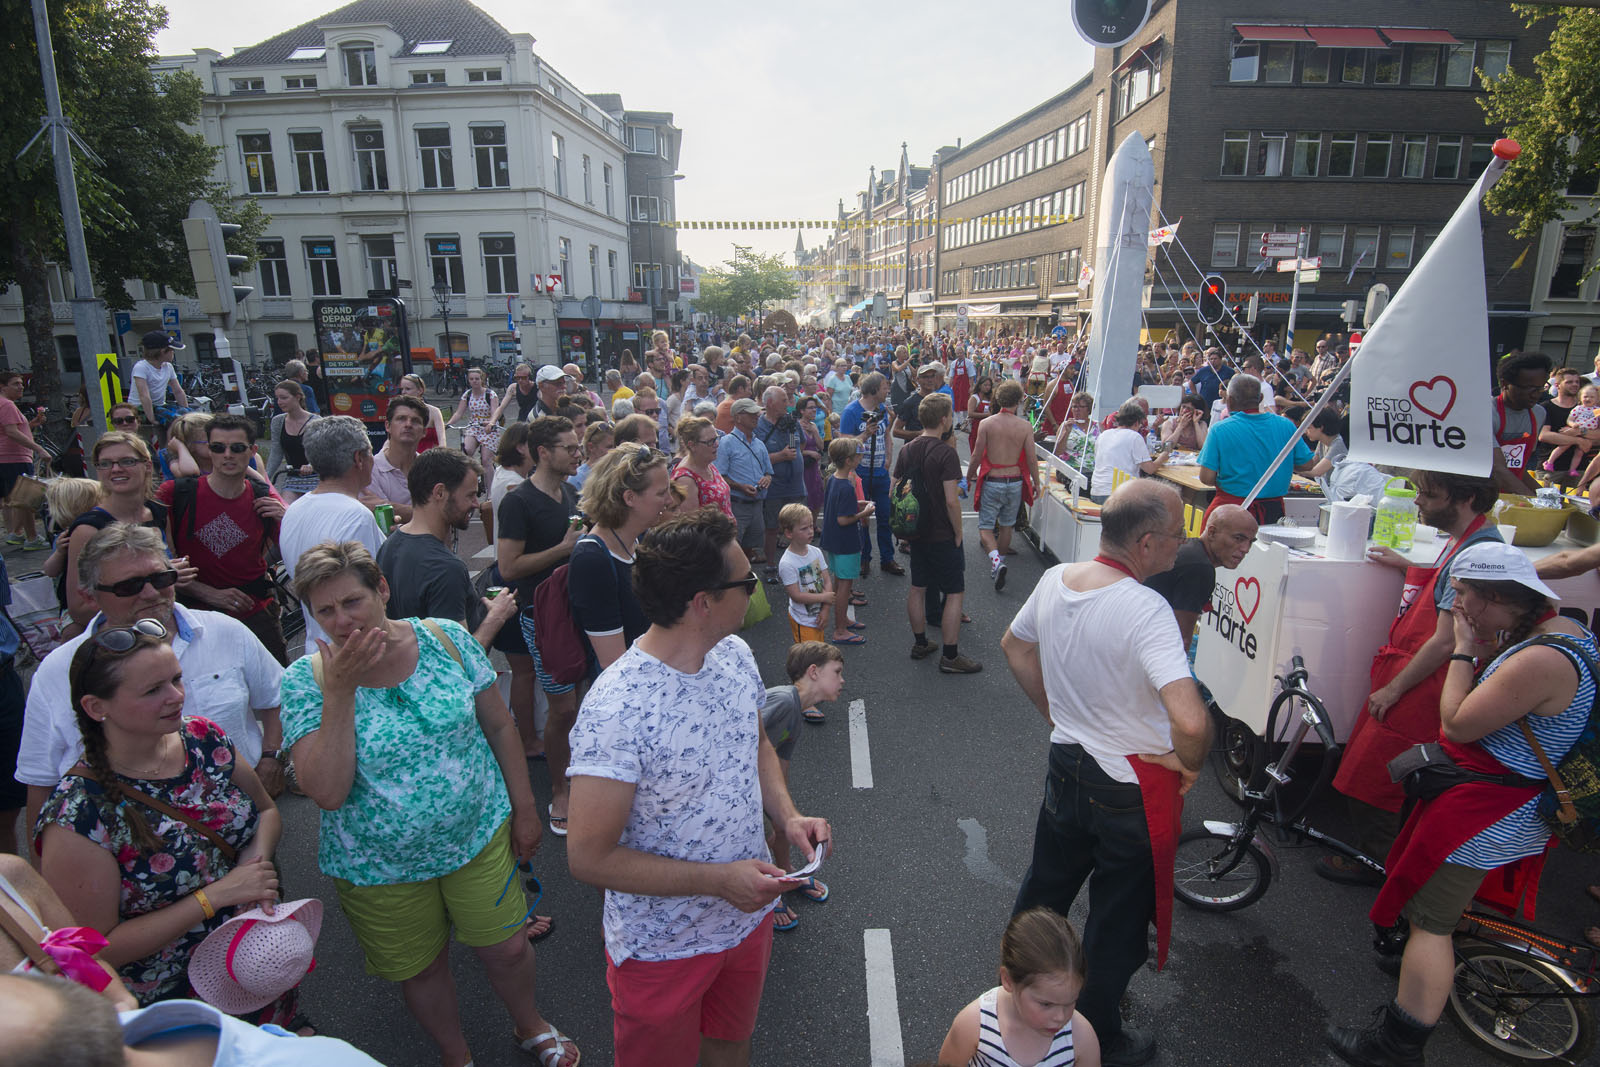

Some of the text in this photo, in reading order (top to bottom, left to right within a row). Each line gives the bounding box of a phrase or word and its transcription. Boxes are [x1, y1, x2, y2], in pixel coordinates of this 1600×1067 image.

[320, 306, 352, 315] GRAND
[120, 319, 127, 329] P
[322, 313, 357, 323] DÉPART
[1367, 396, 1412, 412] RESTO
[1390, 411, 1413, 422] van
[1367, 410, 1466, 450] Harte
[1470, 562, 1505, 570] ProDemos
[1214, 582, 1235, 606] ESTO
[1221, 601, 1233, 617] van
[1207, 594, 1257, 660] Harte
